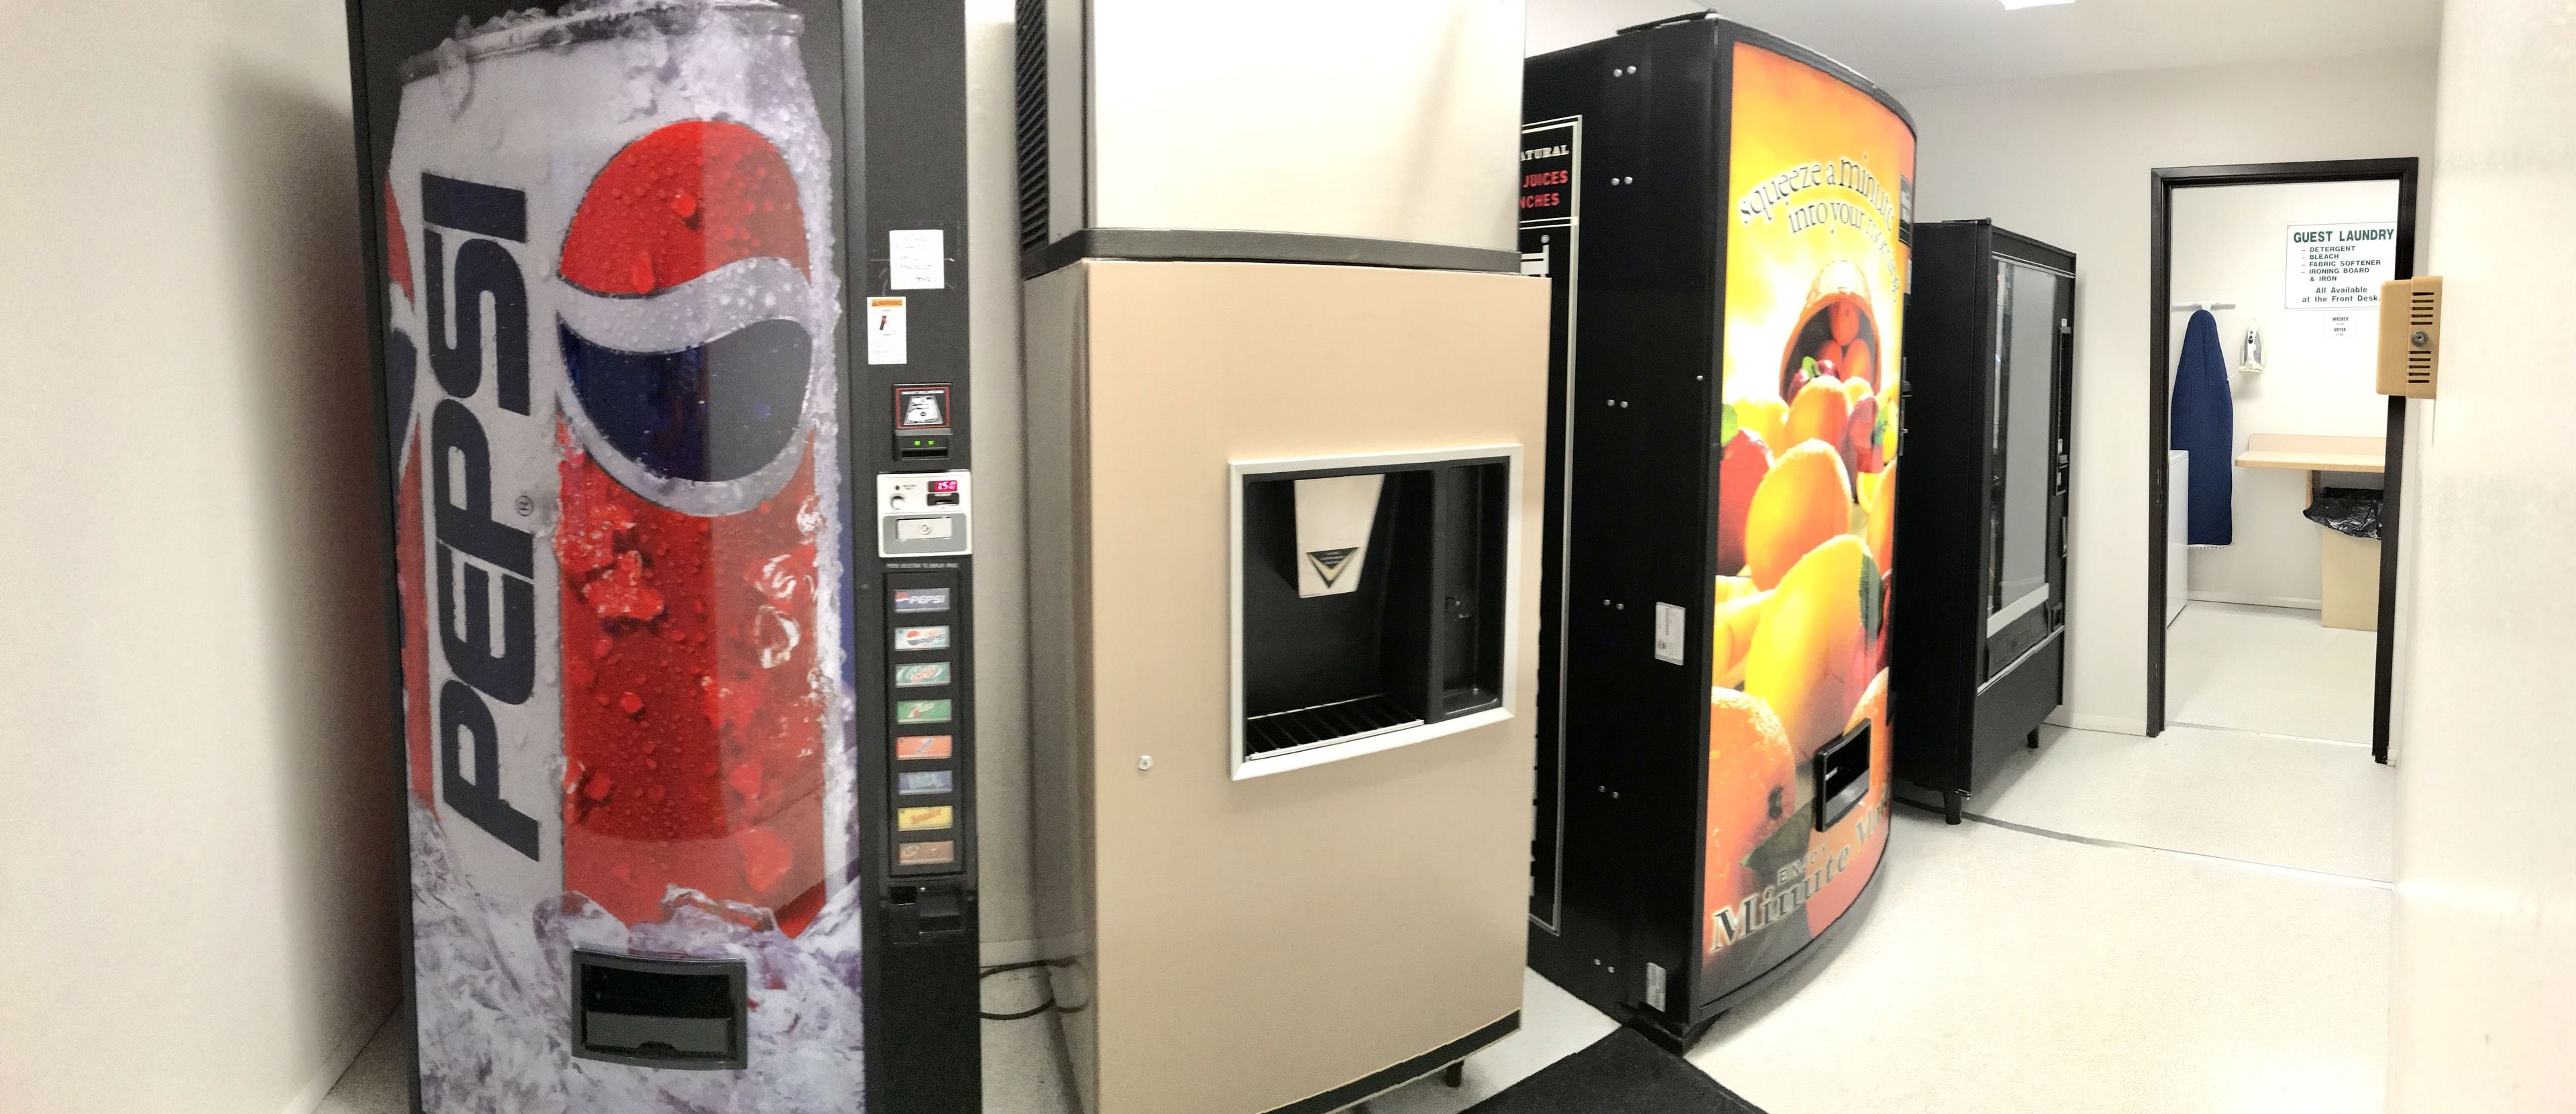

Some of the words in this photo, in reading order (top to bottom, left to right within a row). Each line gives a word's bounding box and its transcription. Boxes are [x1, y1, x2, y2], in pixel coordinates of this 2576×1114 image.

[1520, 144, 1569, 161] ATURAL
[1523, 170, 1568, 188] JUICES
[1519, 192, 1560, 209] NCHES
[1740, 164, 1821, 224] squeeze
[1826, 164, 1837, 186] a
[1840, 155, 1894, 231] minute
[1788, 203, 1829, 234] into
[1829, 203, 1866, 234] your
[2294, 231, 2333, 243] GUEST
[2339, 229, 2394, 241] LAUNDRY
[421, 172, 539, 862] PEPSI
[909, 594, 946, 605] PEPSI
[1711, 844, 1849, 952] Minute
